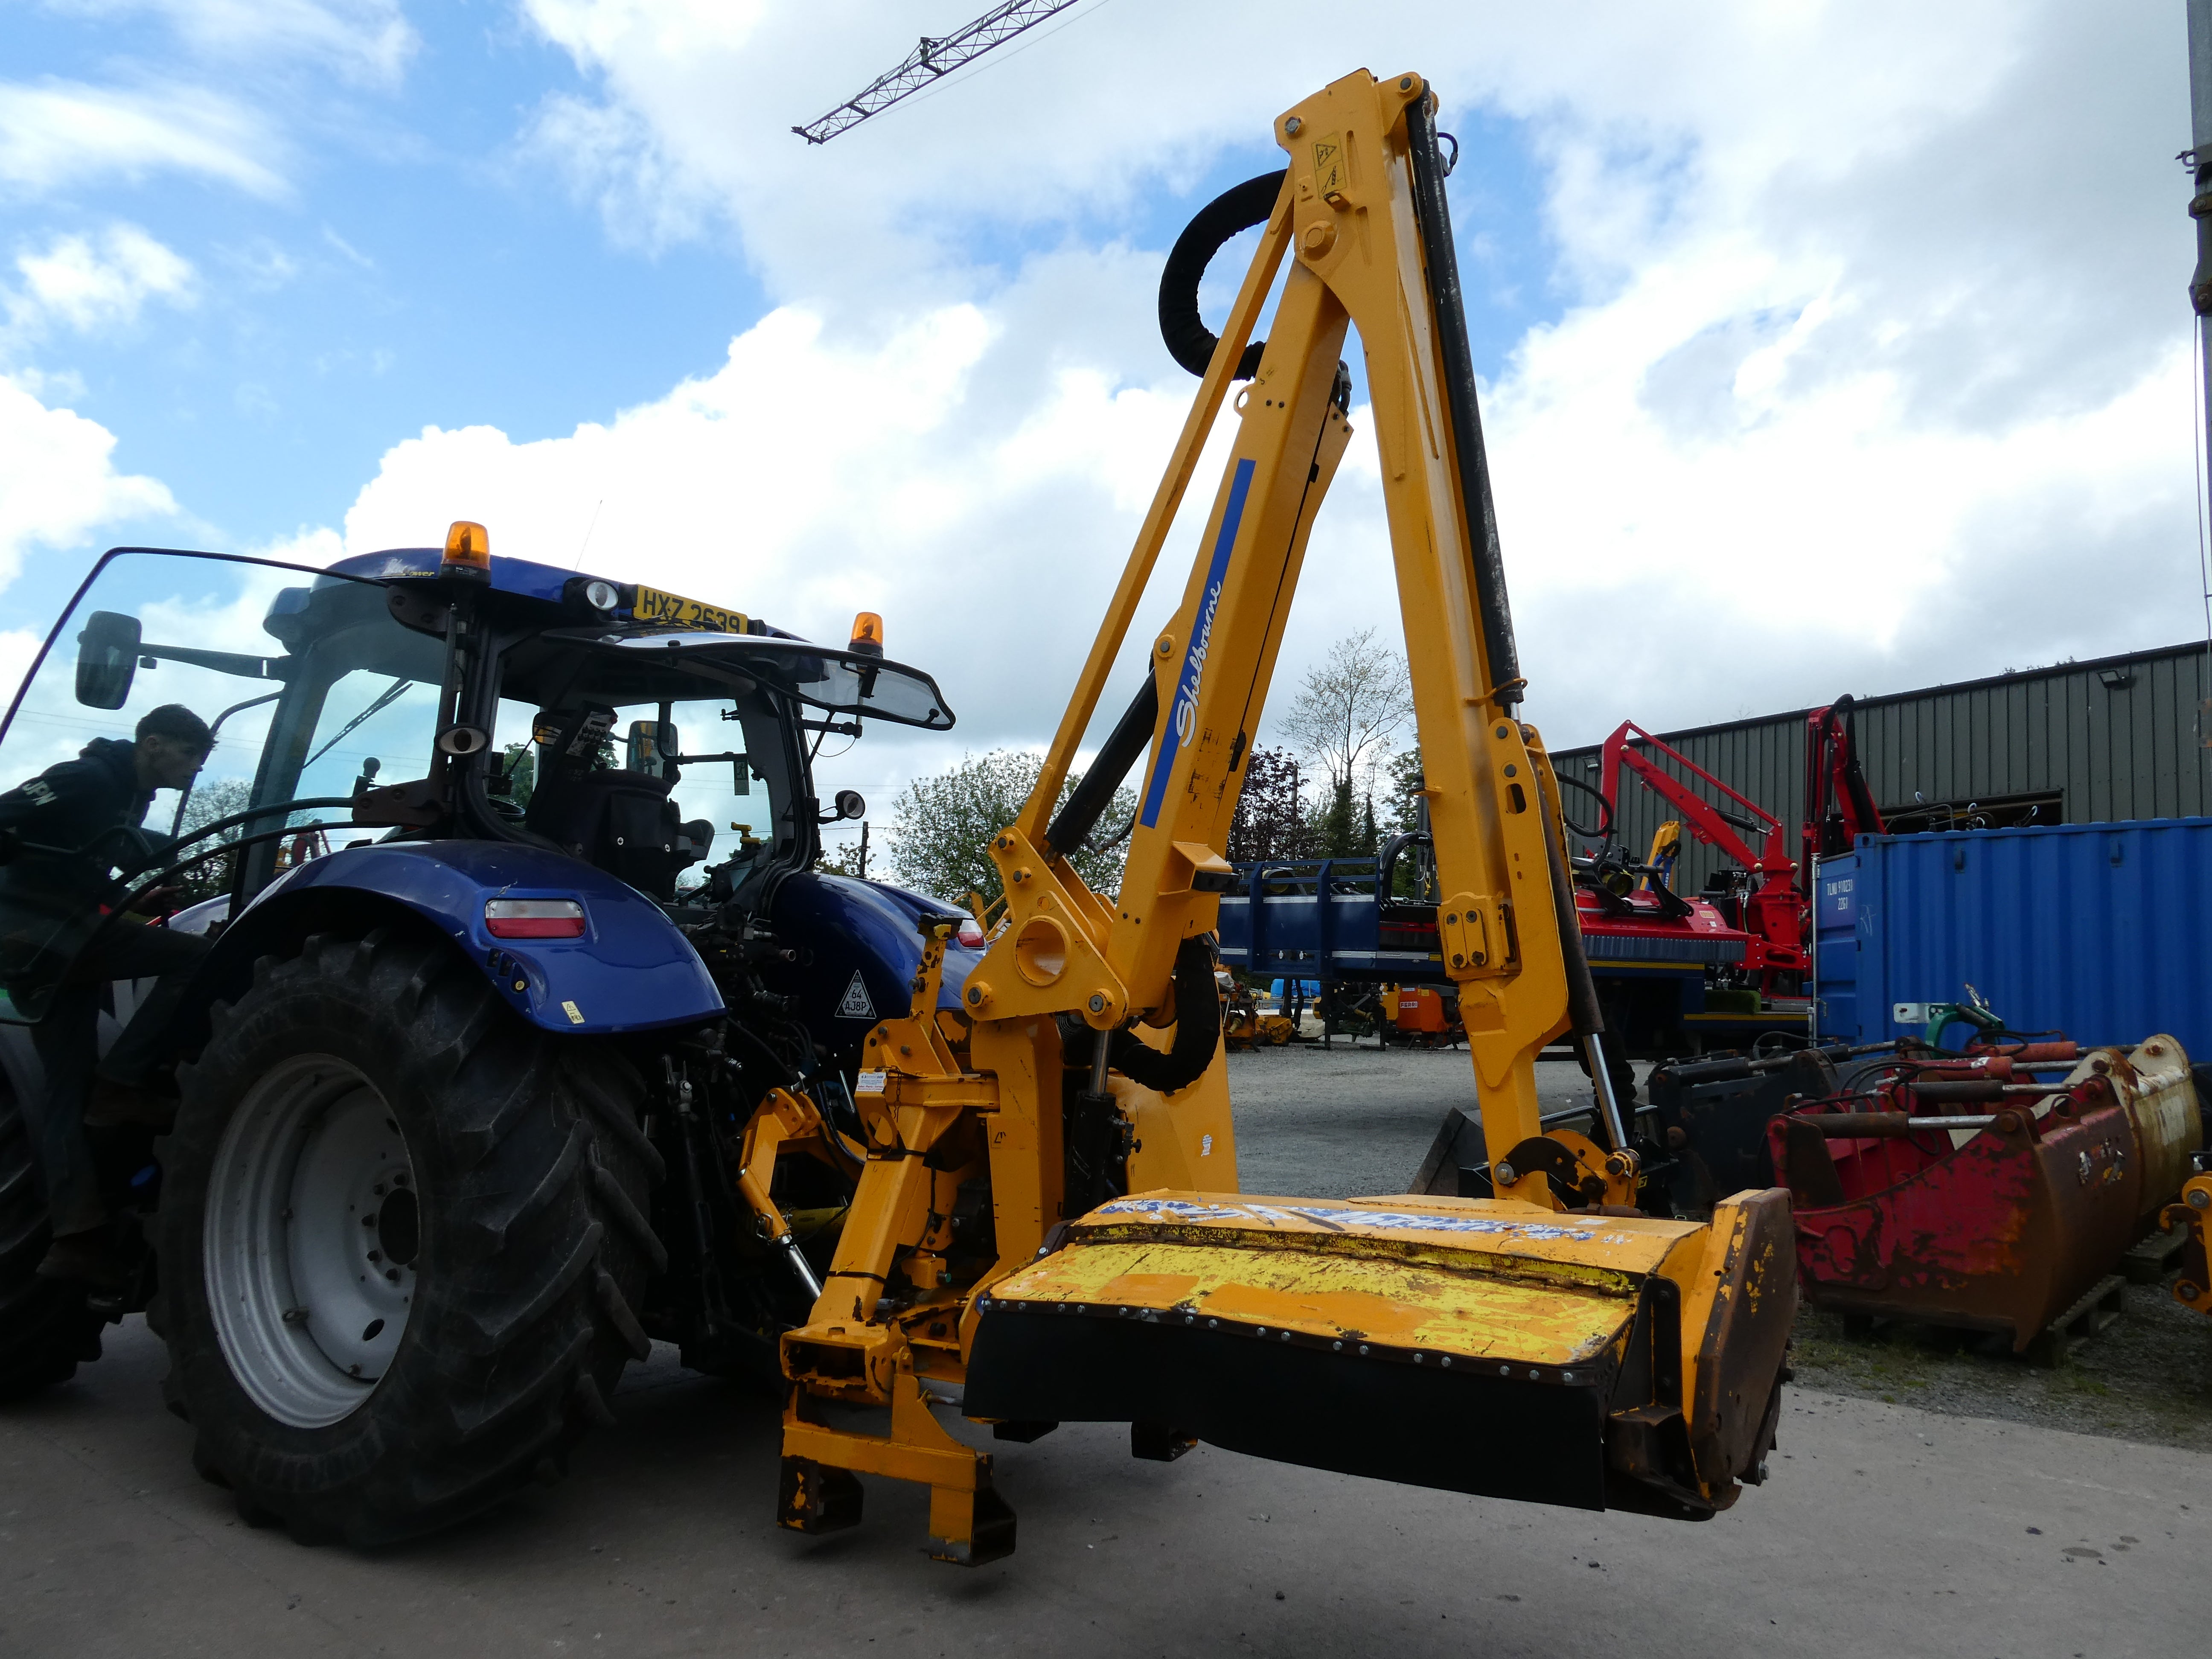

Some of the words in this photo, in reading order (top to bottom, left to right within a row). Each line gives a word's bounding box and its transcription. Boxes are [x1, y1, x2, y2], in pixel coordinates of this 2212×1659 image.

[643, 590, 684, 622] HXZ
[690, 604, 740, 634] 2639
[1176, 581, 1221, 747] Shelbourne
[845, 1001, 867, 1011] AJ8P
[852, 989, 862, 999] 64
